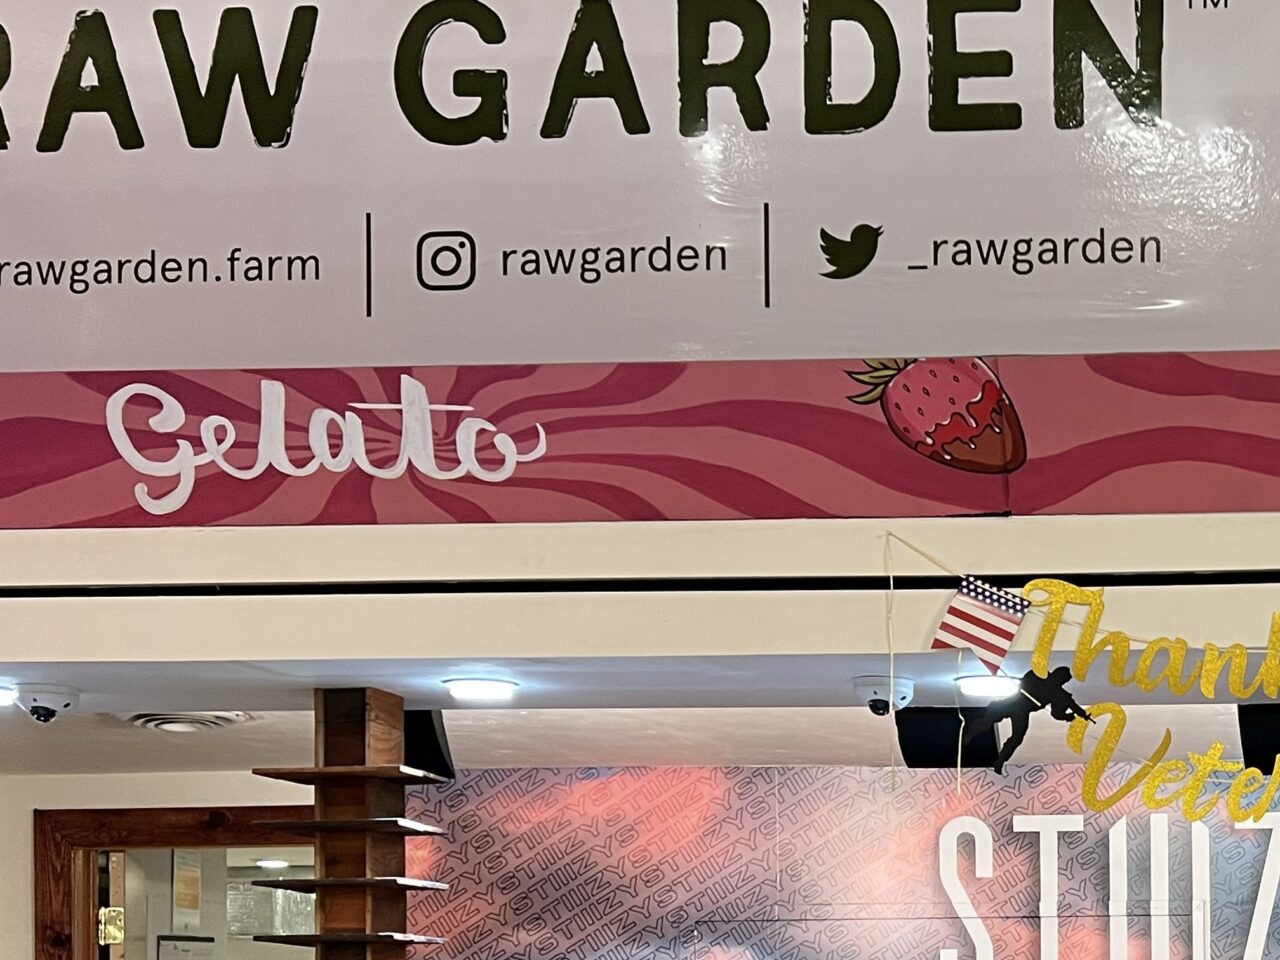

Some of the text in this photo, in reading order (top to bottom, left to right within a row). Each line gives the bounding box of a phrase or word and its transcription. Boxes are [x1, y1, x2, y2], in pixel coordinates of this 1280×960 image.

[0, 0, 1164, 152] AW GARDEN
[501, 236, 727, 284] rawgarden
[907, 228, 1162, 275] _rawgarden
[106, 374, 547, 515] Gelato
